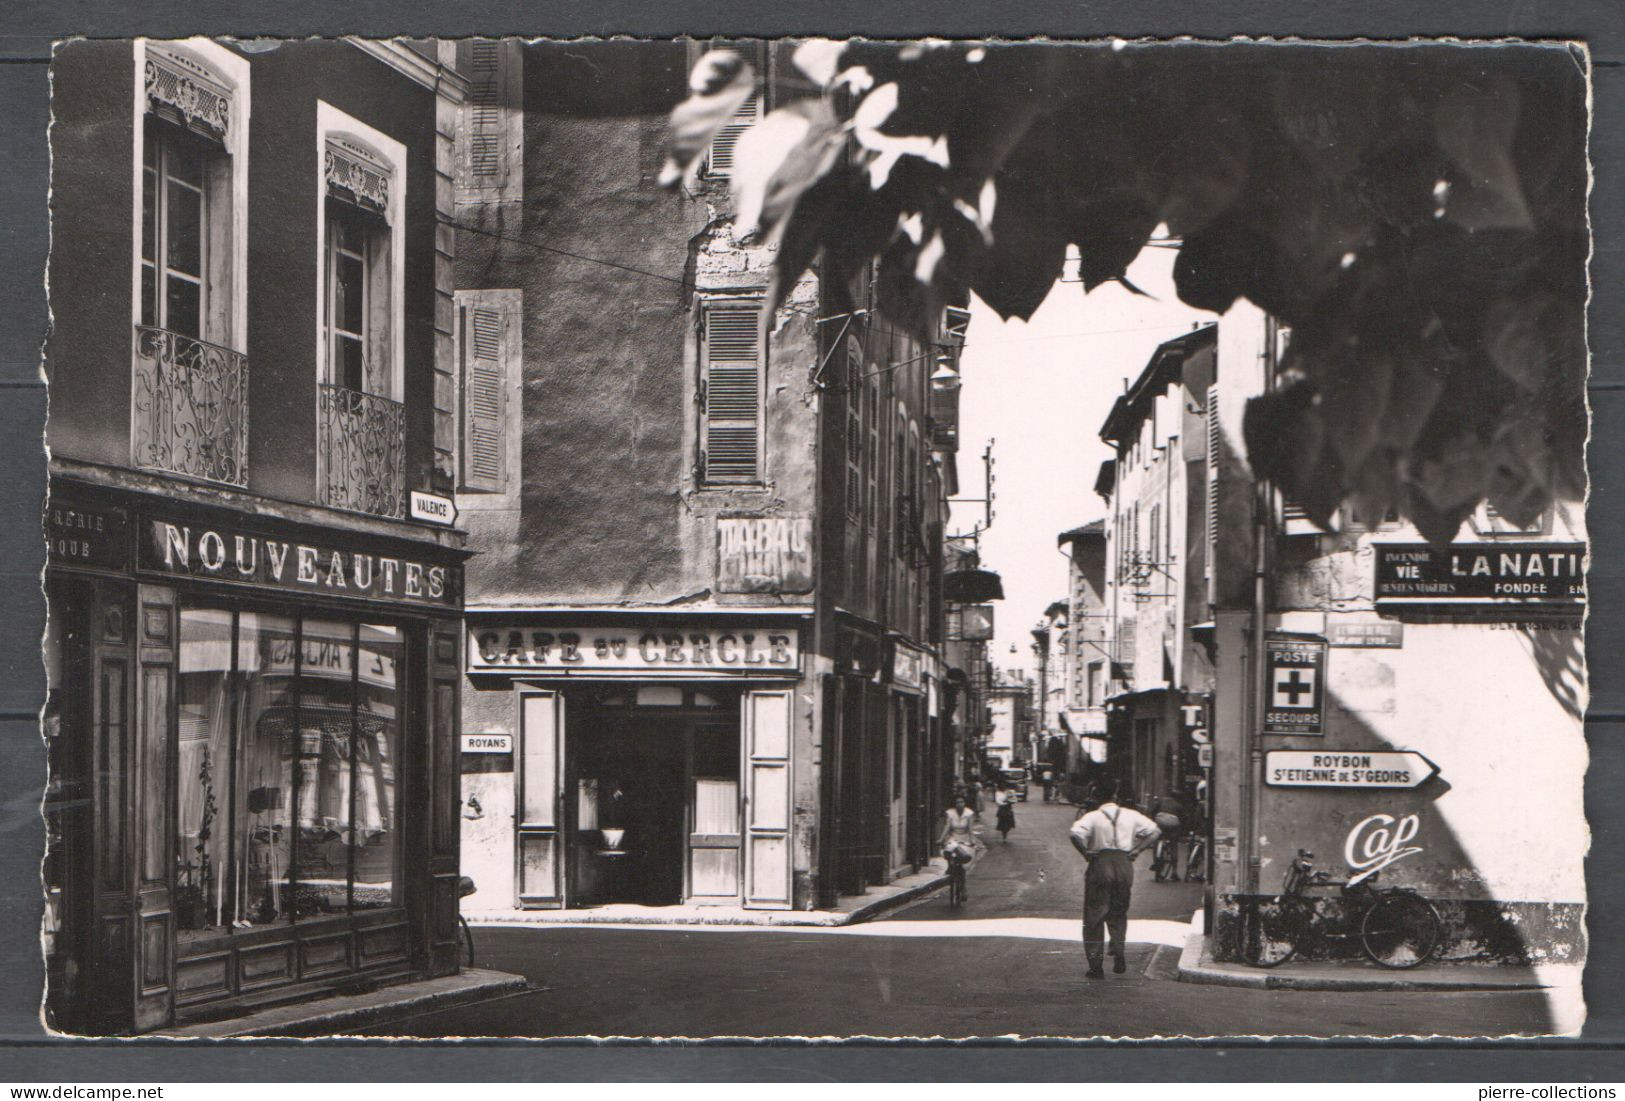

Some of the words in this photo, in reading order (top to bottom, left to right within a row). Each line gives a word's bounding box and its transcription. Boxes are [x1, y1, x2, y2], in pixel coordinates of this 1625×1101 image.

[416, 498, 447, 517] VALENCE
[717, 518, 808, 554] TABAC
[163, 523, 446, 598] NOUVEAUTES
[1451, 555, 1492, 577] LA
[1499, 552, 1584, 577] NATI
[1395, 562, 1420, 579] VIE
[477, 631, 583, 664] CAFE
[638, 633, 793, 664] CERCLE
[1273, 651, 1318, 663] POSTE
[1266, 712, 1320, 724] SECOURS
[468, 737, 507, 750] ROYANS
[1313, 755, 1371, 769] ROYBON
[1344, 813, 1424, 888] Cap
